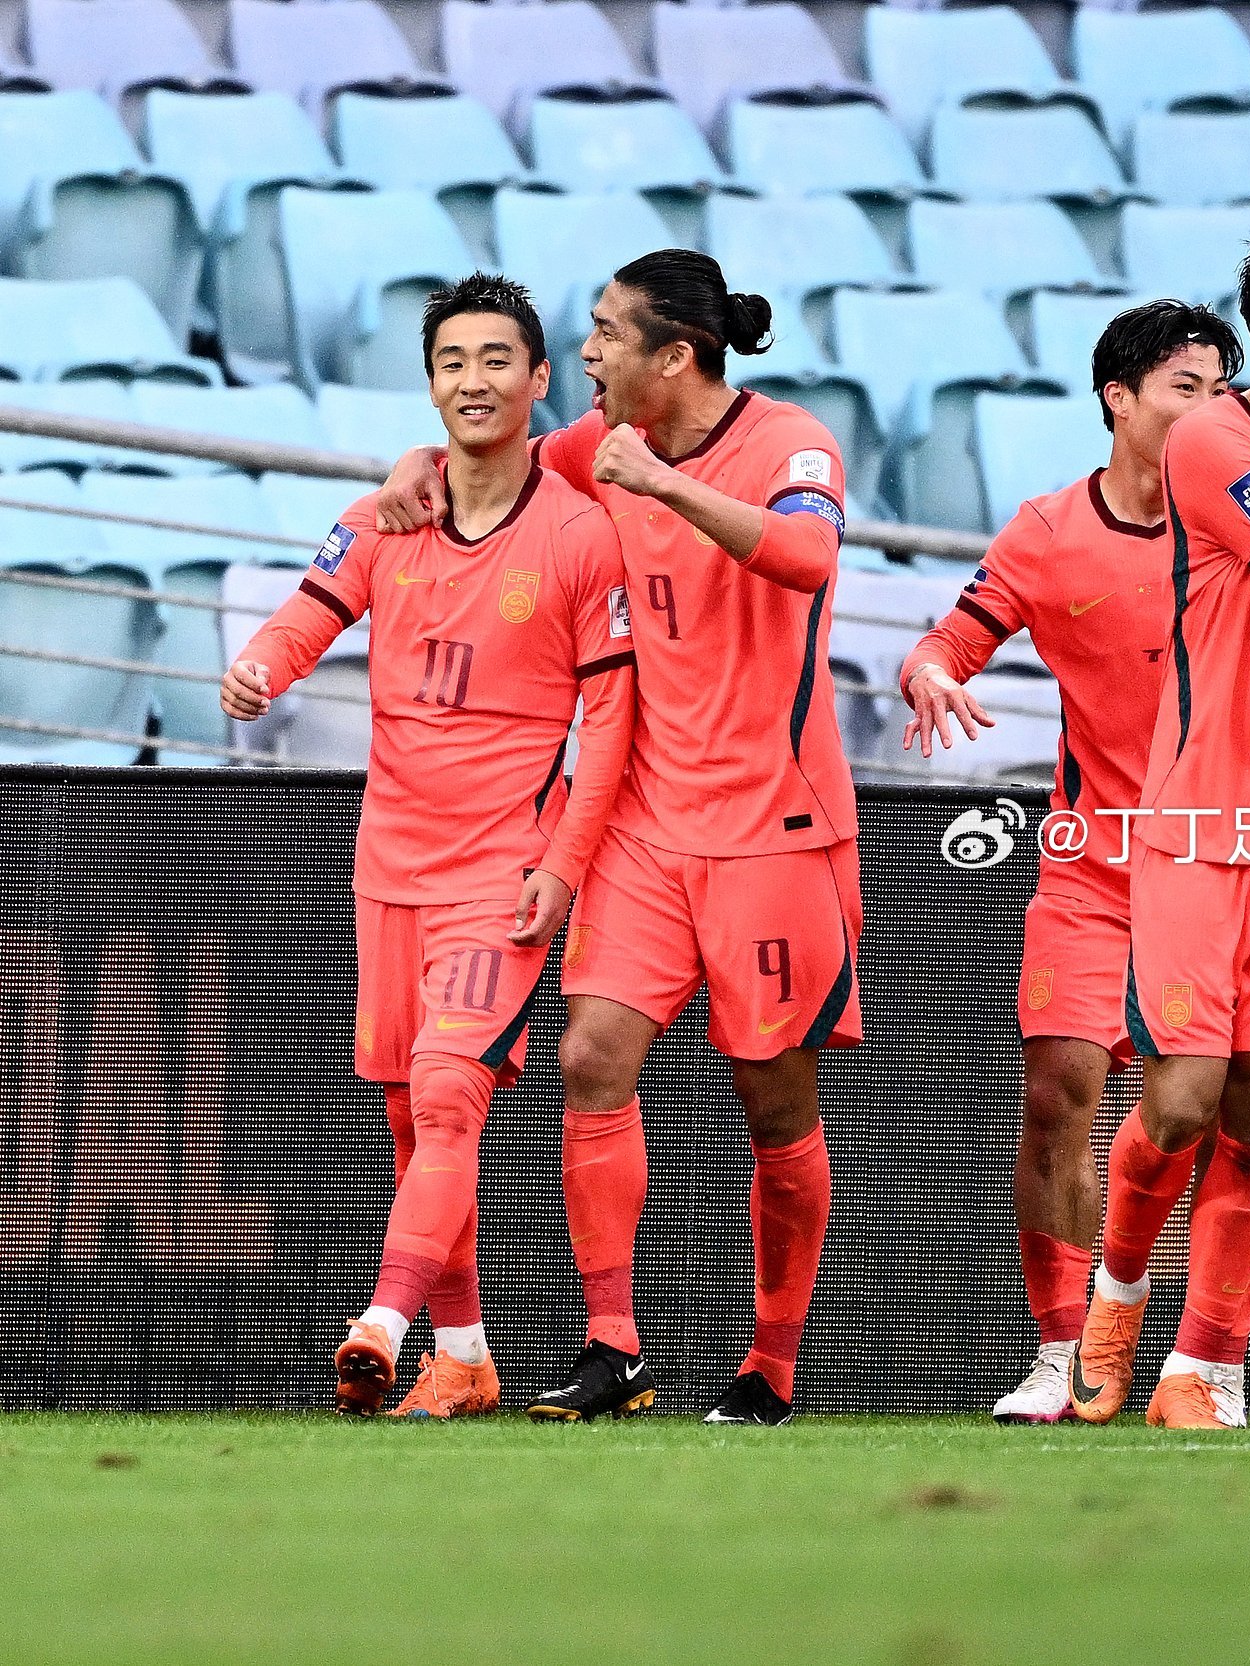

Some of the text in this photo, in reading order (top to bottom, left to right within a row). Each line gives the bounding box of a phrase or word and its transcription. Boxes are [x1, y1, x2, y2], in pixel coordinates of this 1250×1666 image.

[506, 571, 537, 586] CFA
[644, 574, 682, 640] 9
[413, 637, 474, 711] 10
[440, 949, 502, 1013] 10
[752, 938, 795, 1004] 9
[1030, 970, 1053, 981] CFA
[1165, 986, 1190, 995] CFA
